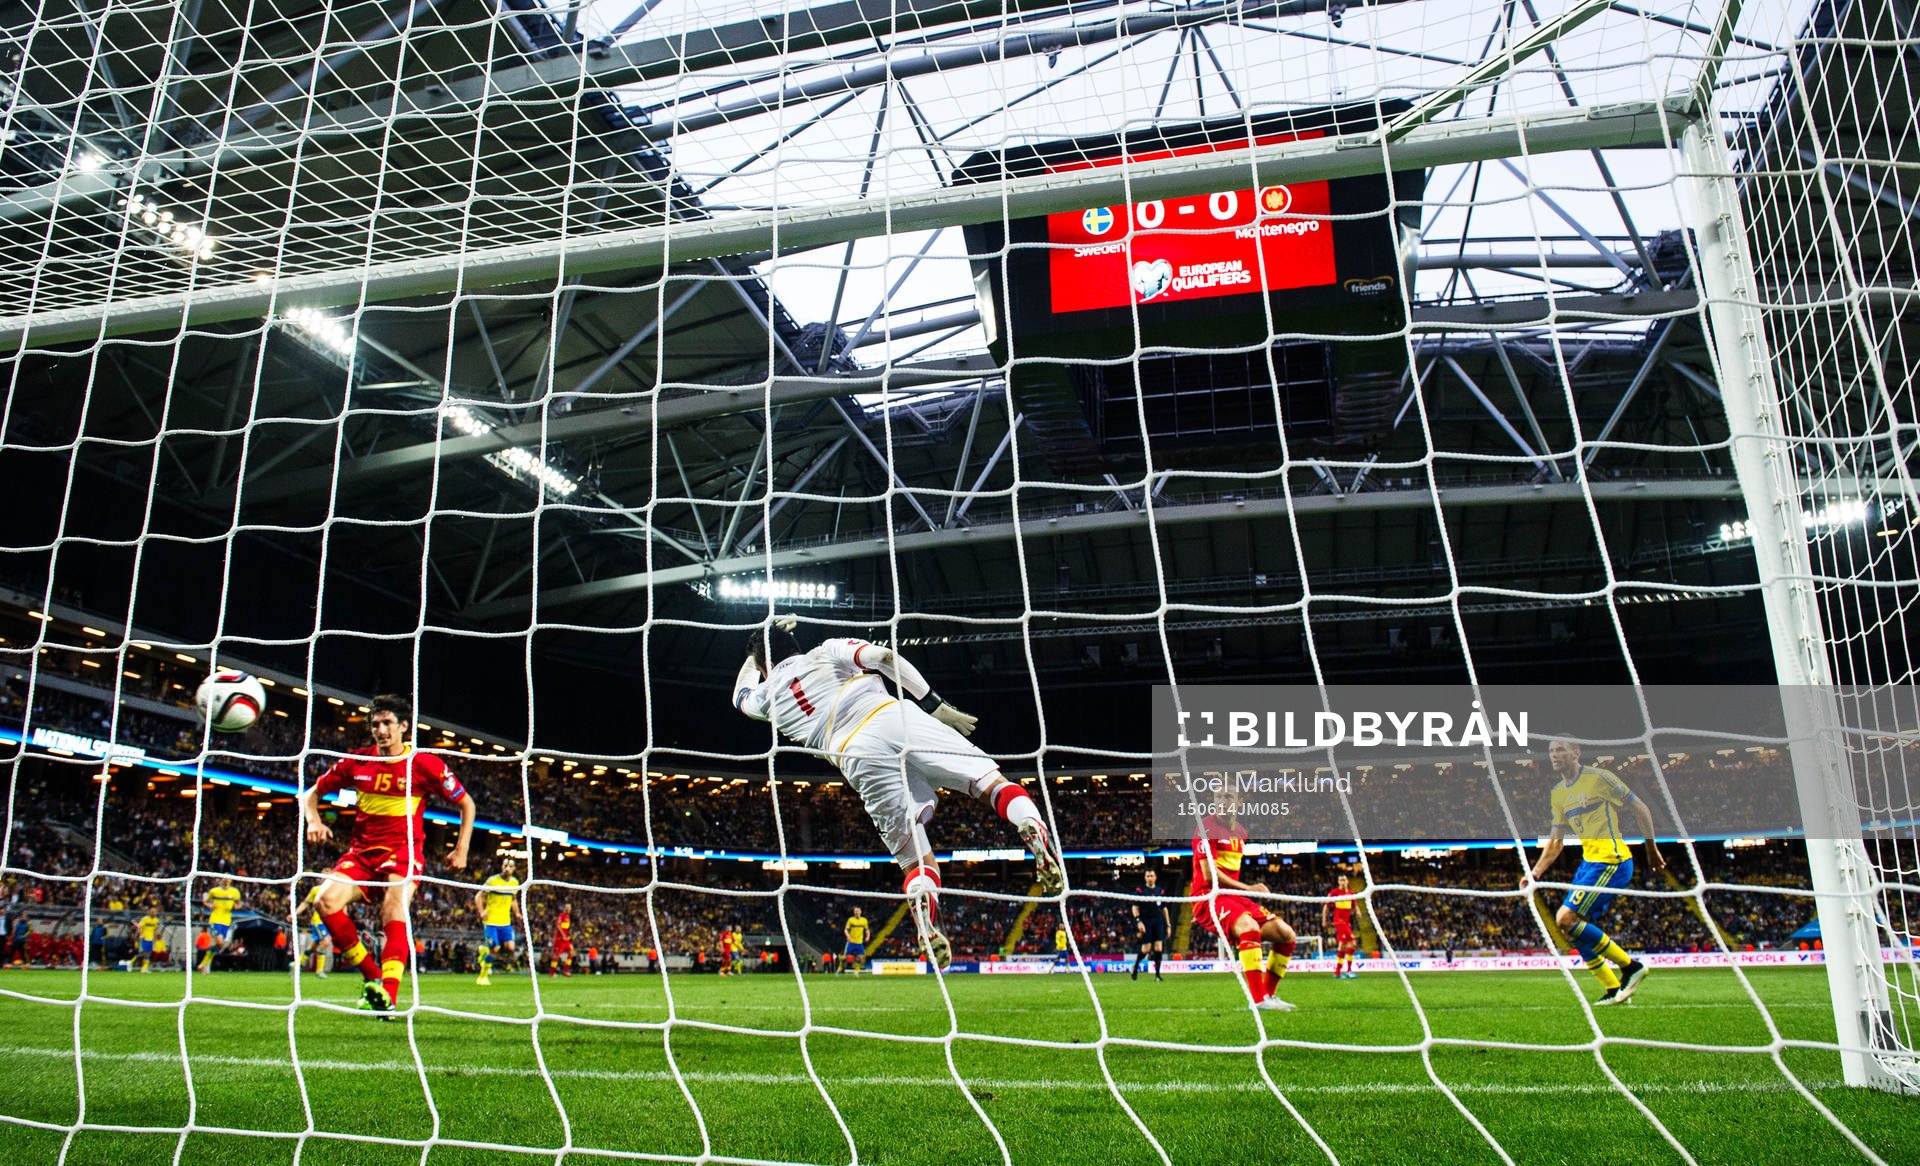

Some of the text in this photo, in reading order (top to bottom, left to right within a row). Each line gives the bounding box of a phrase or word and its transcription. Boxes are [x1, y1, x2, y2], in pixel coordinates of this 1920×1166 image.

[1235, 220, 1319, 239] Montenegro
[1074, 242, 1126, 257] Sweden
[1179, 260, 1242, 277] EUROPEAN
[1172, 270, 1251, 292] QUALIFIERS
[1351, 280, 1387, 293] friends
[789, 677, 816, 717] 1
[374, 773, 393, 792] 15
[1107, 963, 1145, 972] RESPET
[1366, 961, 1421, 969] INTERPORT
